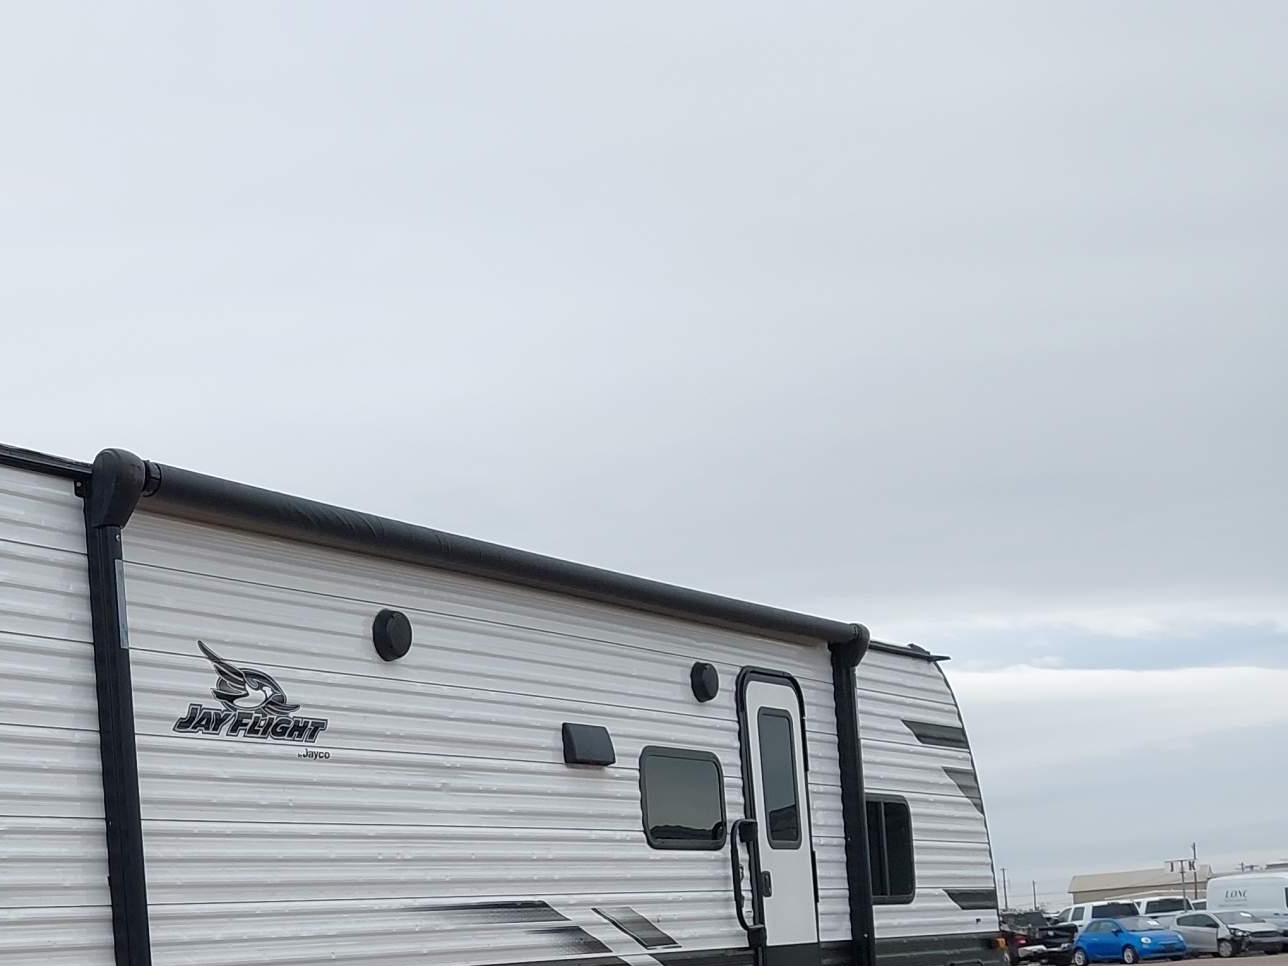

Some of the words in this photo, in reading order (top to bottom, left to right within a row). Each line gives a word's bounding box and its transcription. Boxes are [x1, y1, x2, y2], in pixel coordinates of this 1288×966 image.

[173, 703, 232, 736] JAY
[226, 710, 329, 743] FLIGHT
[303, 748, 330, 761] Jayco
